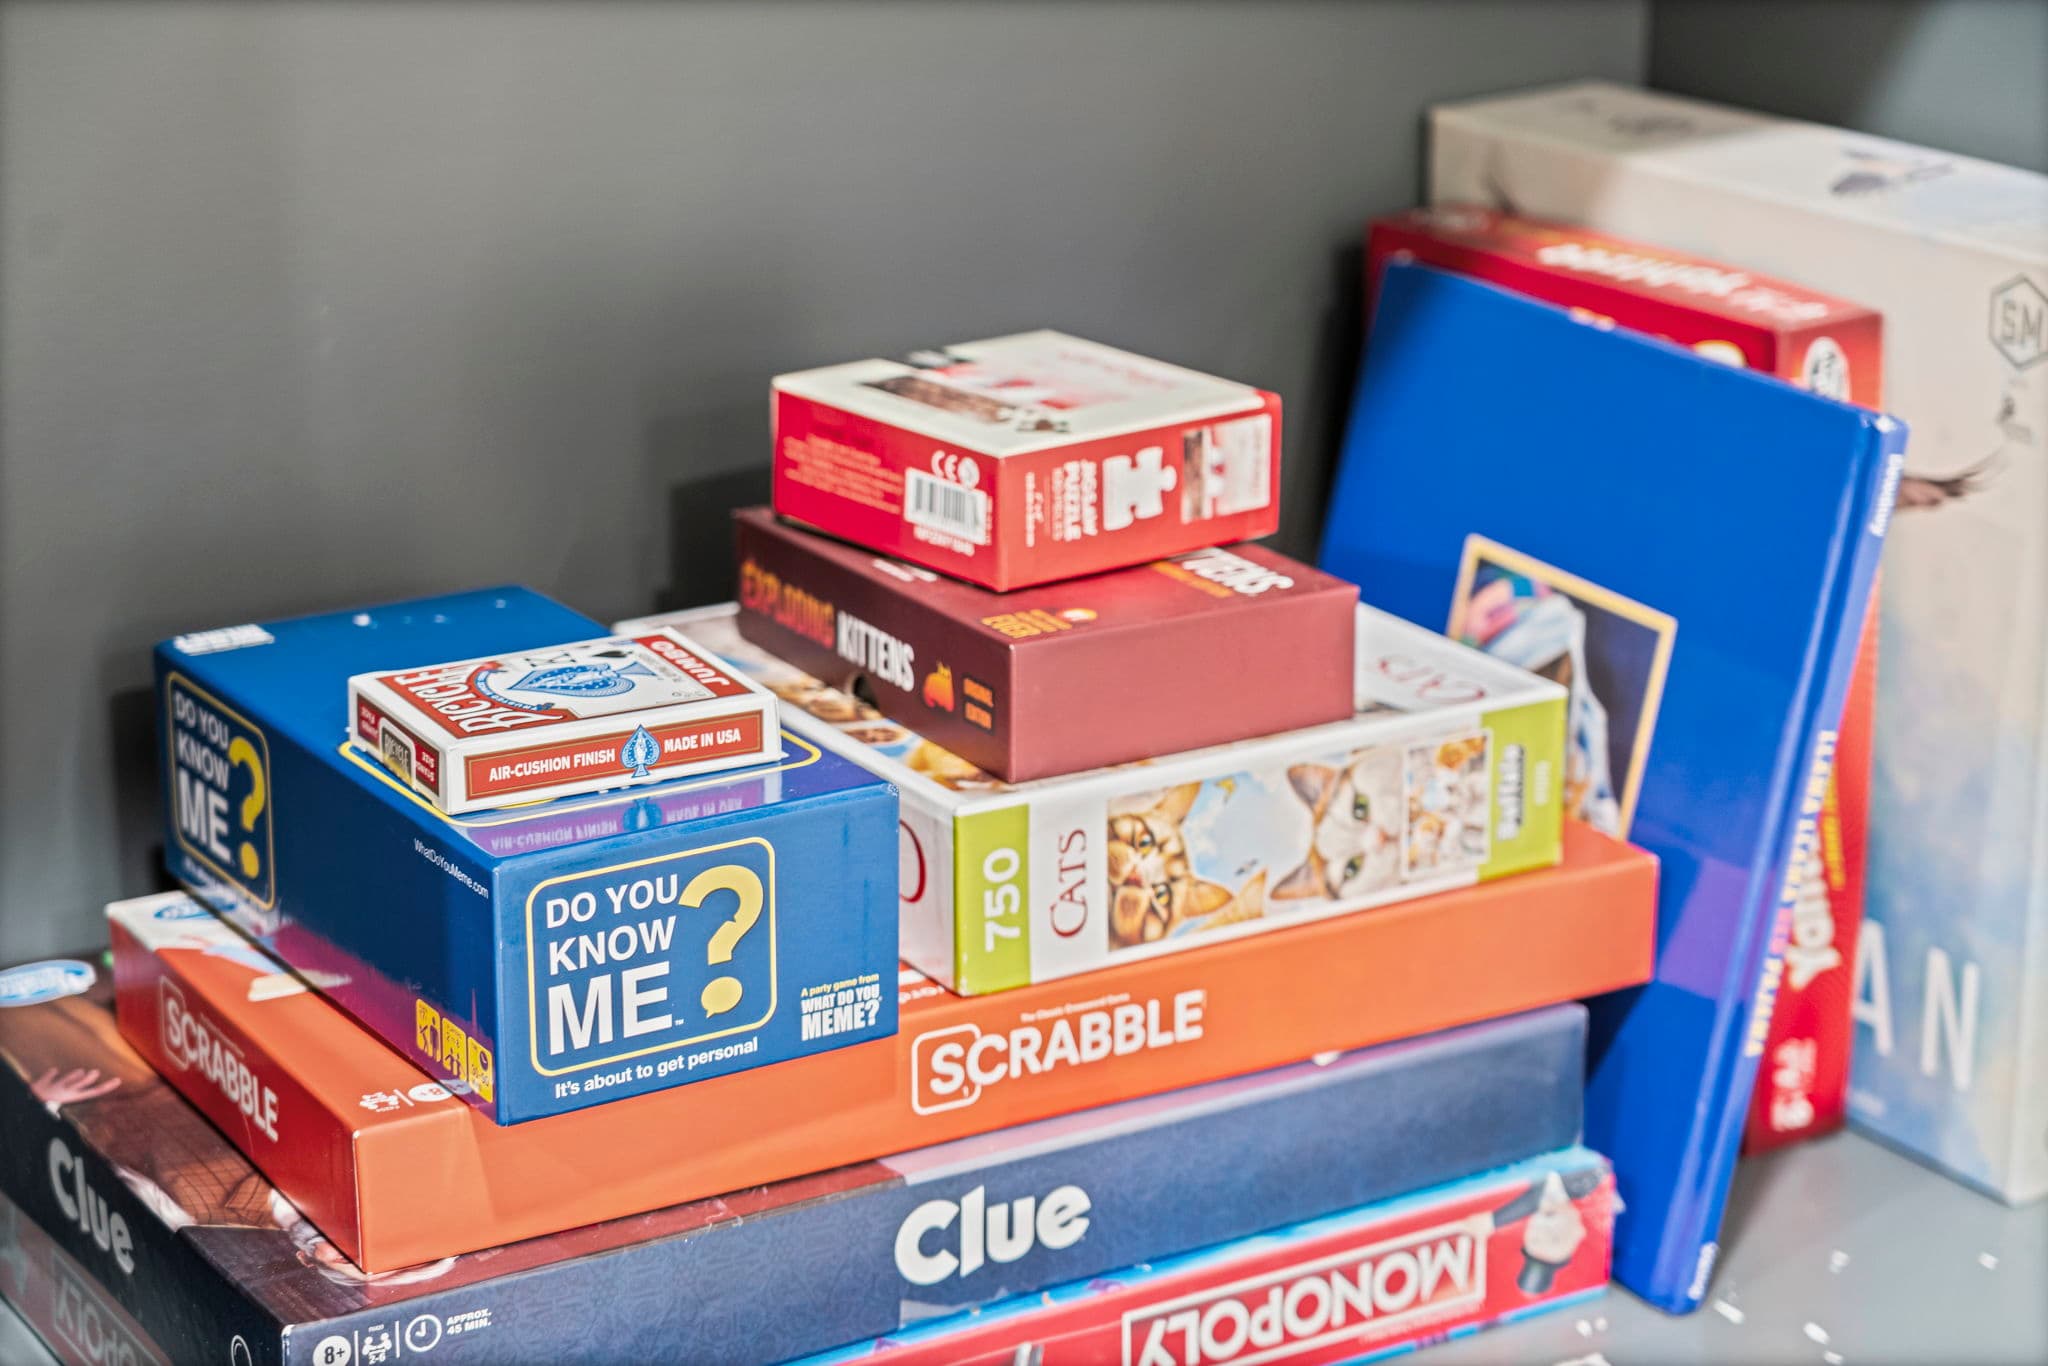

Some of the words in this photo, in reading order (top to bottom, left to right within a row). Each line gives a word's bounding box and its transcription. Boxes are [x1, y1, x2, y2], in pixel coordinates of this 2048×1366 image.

[651, 640, 730, 687] JUMBO
[837, 610, 915, 692] KITTENS
[174, 691, 198, 728] DO
[199, 704, 230, 750] YOU
[664, 734, 698, 754] MADE
[701, 732, 714, 747] IN
[717, 727, 742, 746] USA
[177, 729, 230, 791] KNOW
[489, 754, 571, 783] AIR-CUSHION
[573, 748, 616, 769] FINISH
[414, 838, 489, 899] WhatDoYouMeme.com
[1049, 828, 1089, 938] CATS
[546, 892, 597, 929] DO
[605, 874, 679, 914] YOU
[983, 848, 1021, 953] 750
[549, 915, 677, 976] KNOW
[801, 988, 809, 998] A
[809, 983, 833, 997] party
[833, 978, 858, 992] game
[858, 973, 880, 985] from
[801, 992, 836, 1014] WHAT
[837, 988, 854, 1006] DO
[855, 983, 880, 1001] YOU
[801, 999, 880, 1042] MEME?
[930, 989, 1204, 1096] SCRABBLE
[167, 997, 280, 1143] SCRABBLE
[555, 1082, 580, 1099] It's
[583, 1067, 633, 1092] about
[636, 1065, 654, 1080] to
[657, 1055, 685, 1078] get
[687, 1037, 758, 1069] personal
[48, 1137, 135, 1275] Clue
[894, 1184, 1092, 1286] Clue
[447, 1308, 492, 1326] APPROX.
[447, 1322, 463, 1335] 45
[465, 1316, 492, 1332] MIN.
[1138, 1232, 1474, 1366] MONOPOLY
[324, 1345, 345, 1366] 8+
